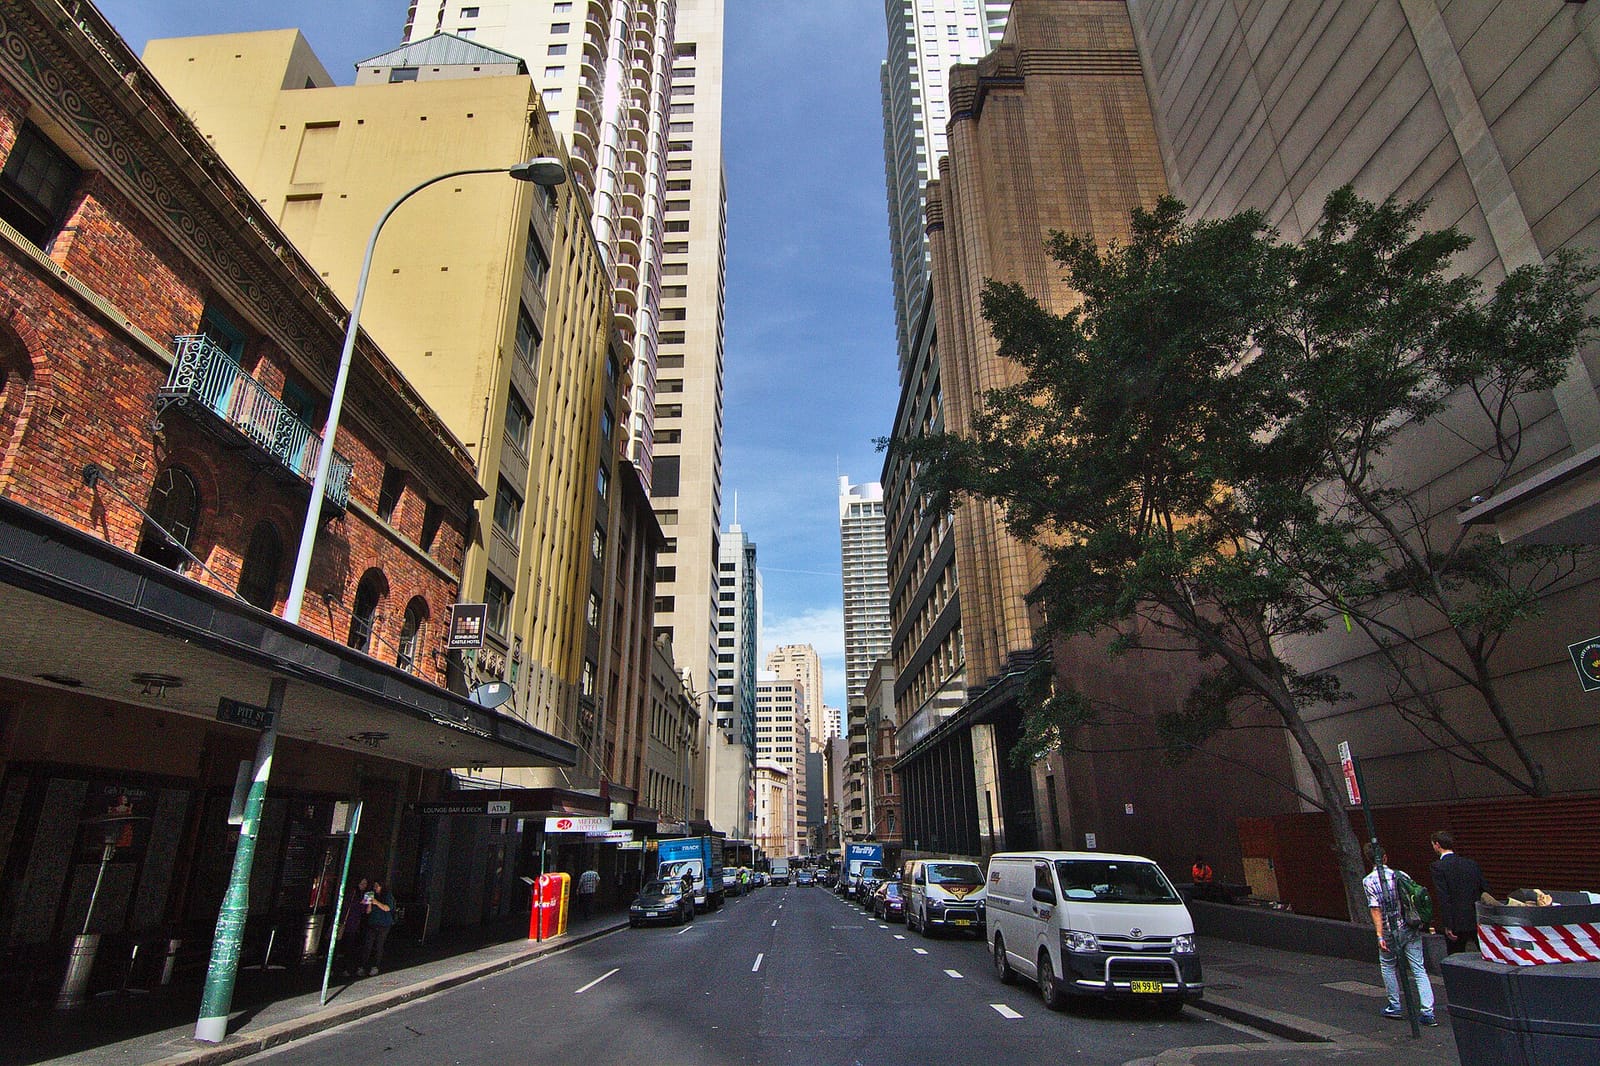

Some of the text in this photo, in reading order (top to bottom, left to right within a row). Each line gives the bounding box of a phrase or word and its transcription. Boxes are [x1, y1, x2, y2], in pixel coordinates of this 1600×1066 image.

[237, 706, 254, 719] PITT
[423, 806, 447, 814] LOUNGE
[491, 804, 507, 812] ATM
[852, 846, 875, 856] Thrifty
